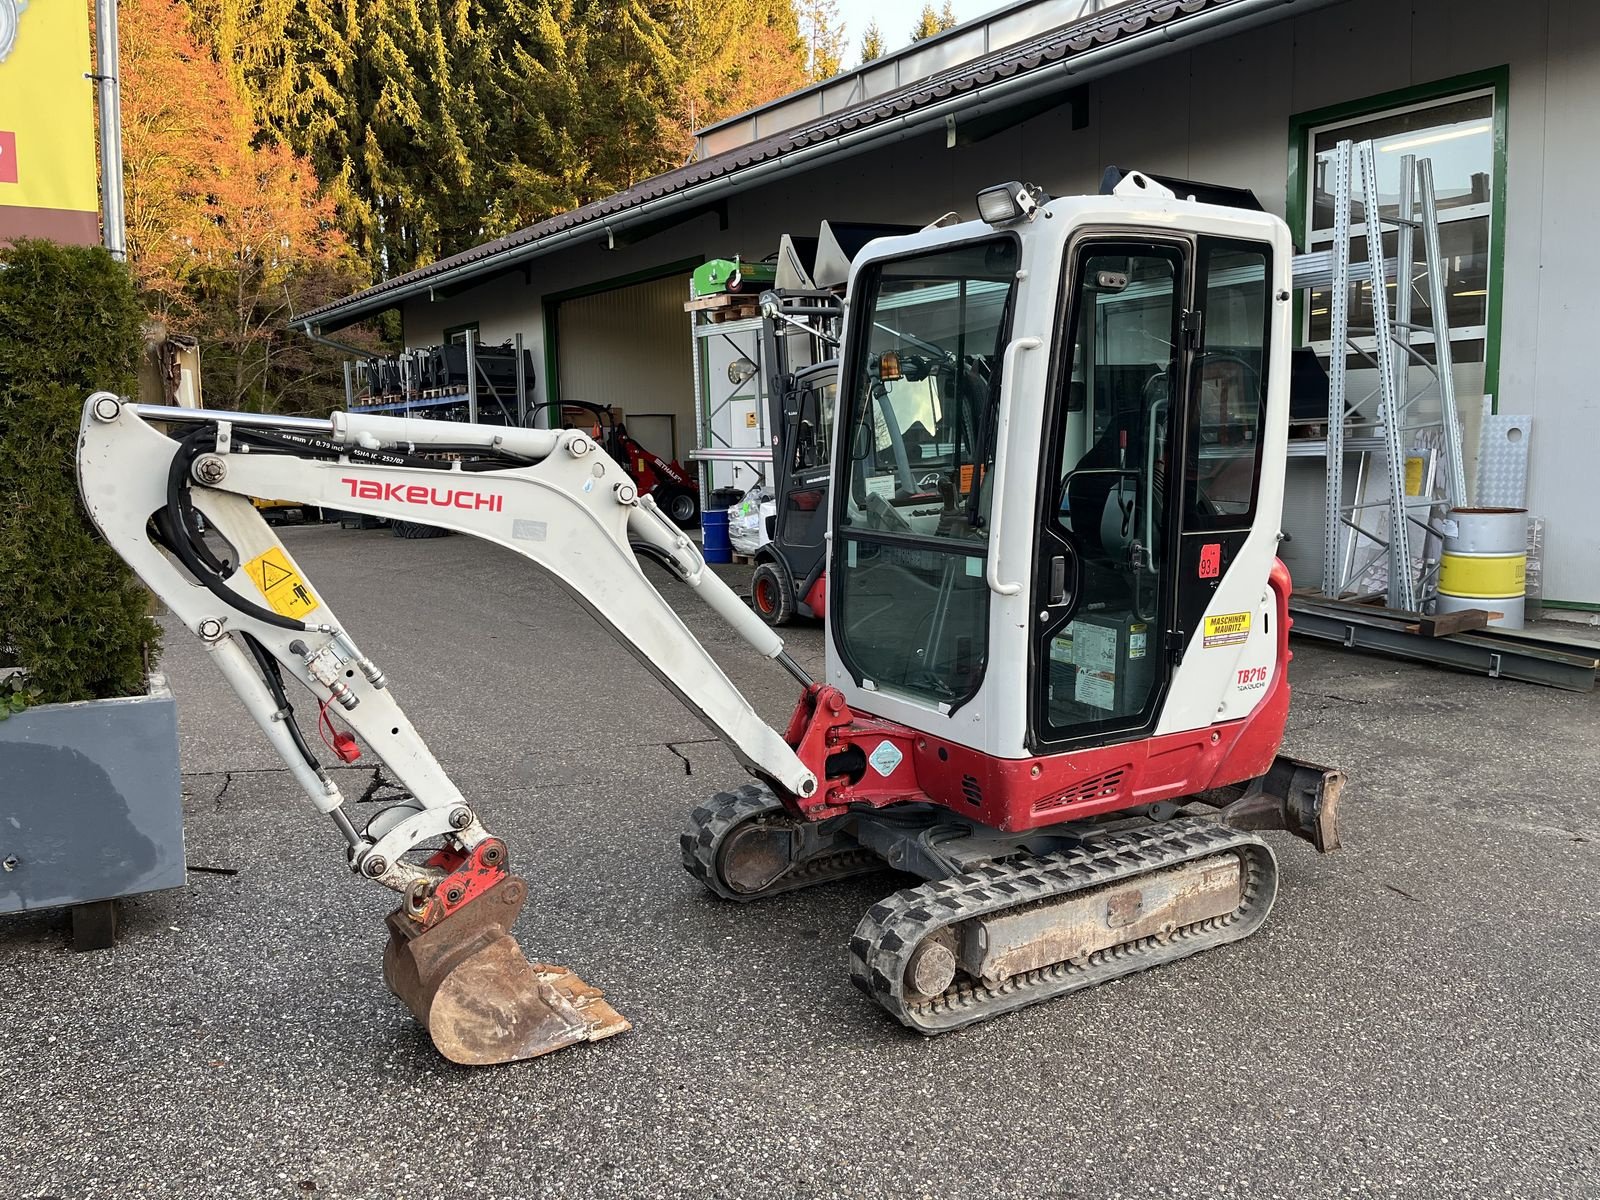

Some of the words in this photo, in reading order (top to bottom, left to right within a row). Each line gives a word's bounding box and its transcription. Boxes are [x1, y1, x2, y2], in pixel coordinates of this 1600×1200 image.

[292, 436, 306, 444] mm
[315, 440, 331, 449] 0.79
[1201, 559, 1211, 575] 93
[1210, 614, 1247, 626] MASCHINEN
[1214, 623, 1242, 634] MAURITZ
[1237, 666, 1267, 684] TB216
